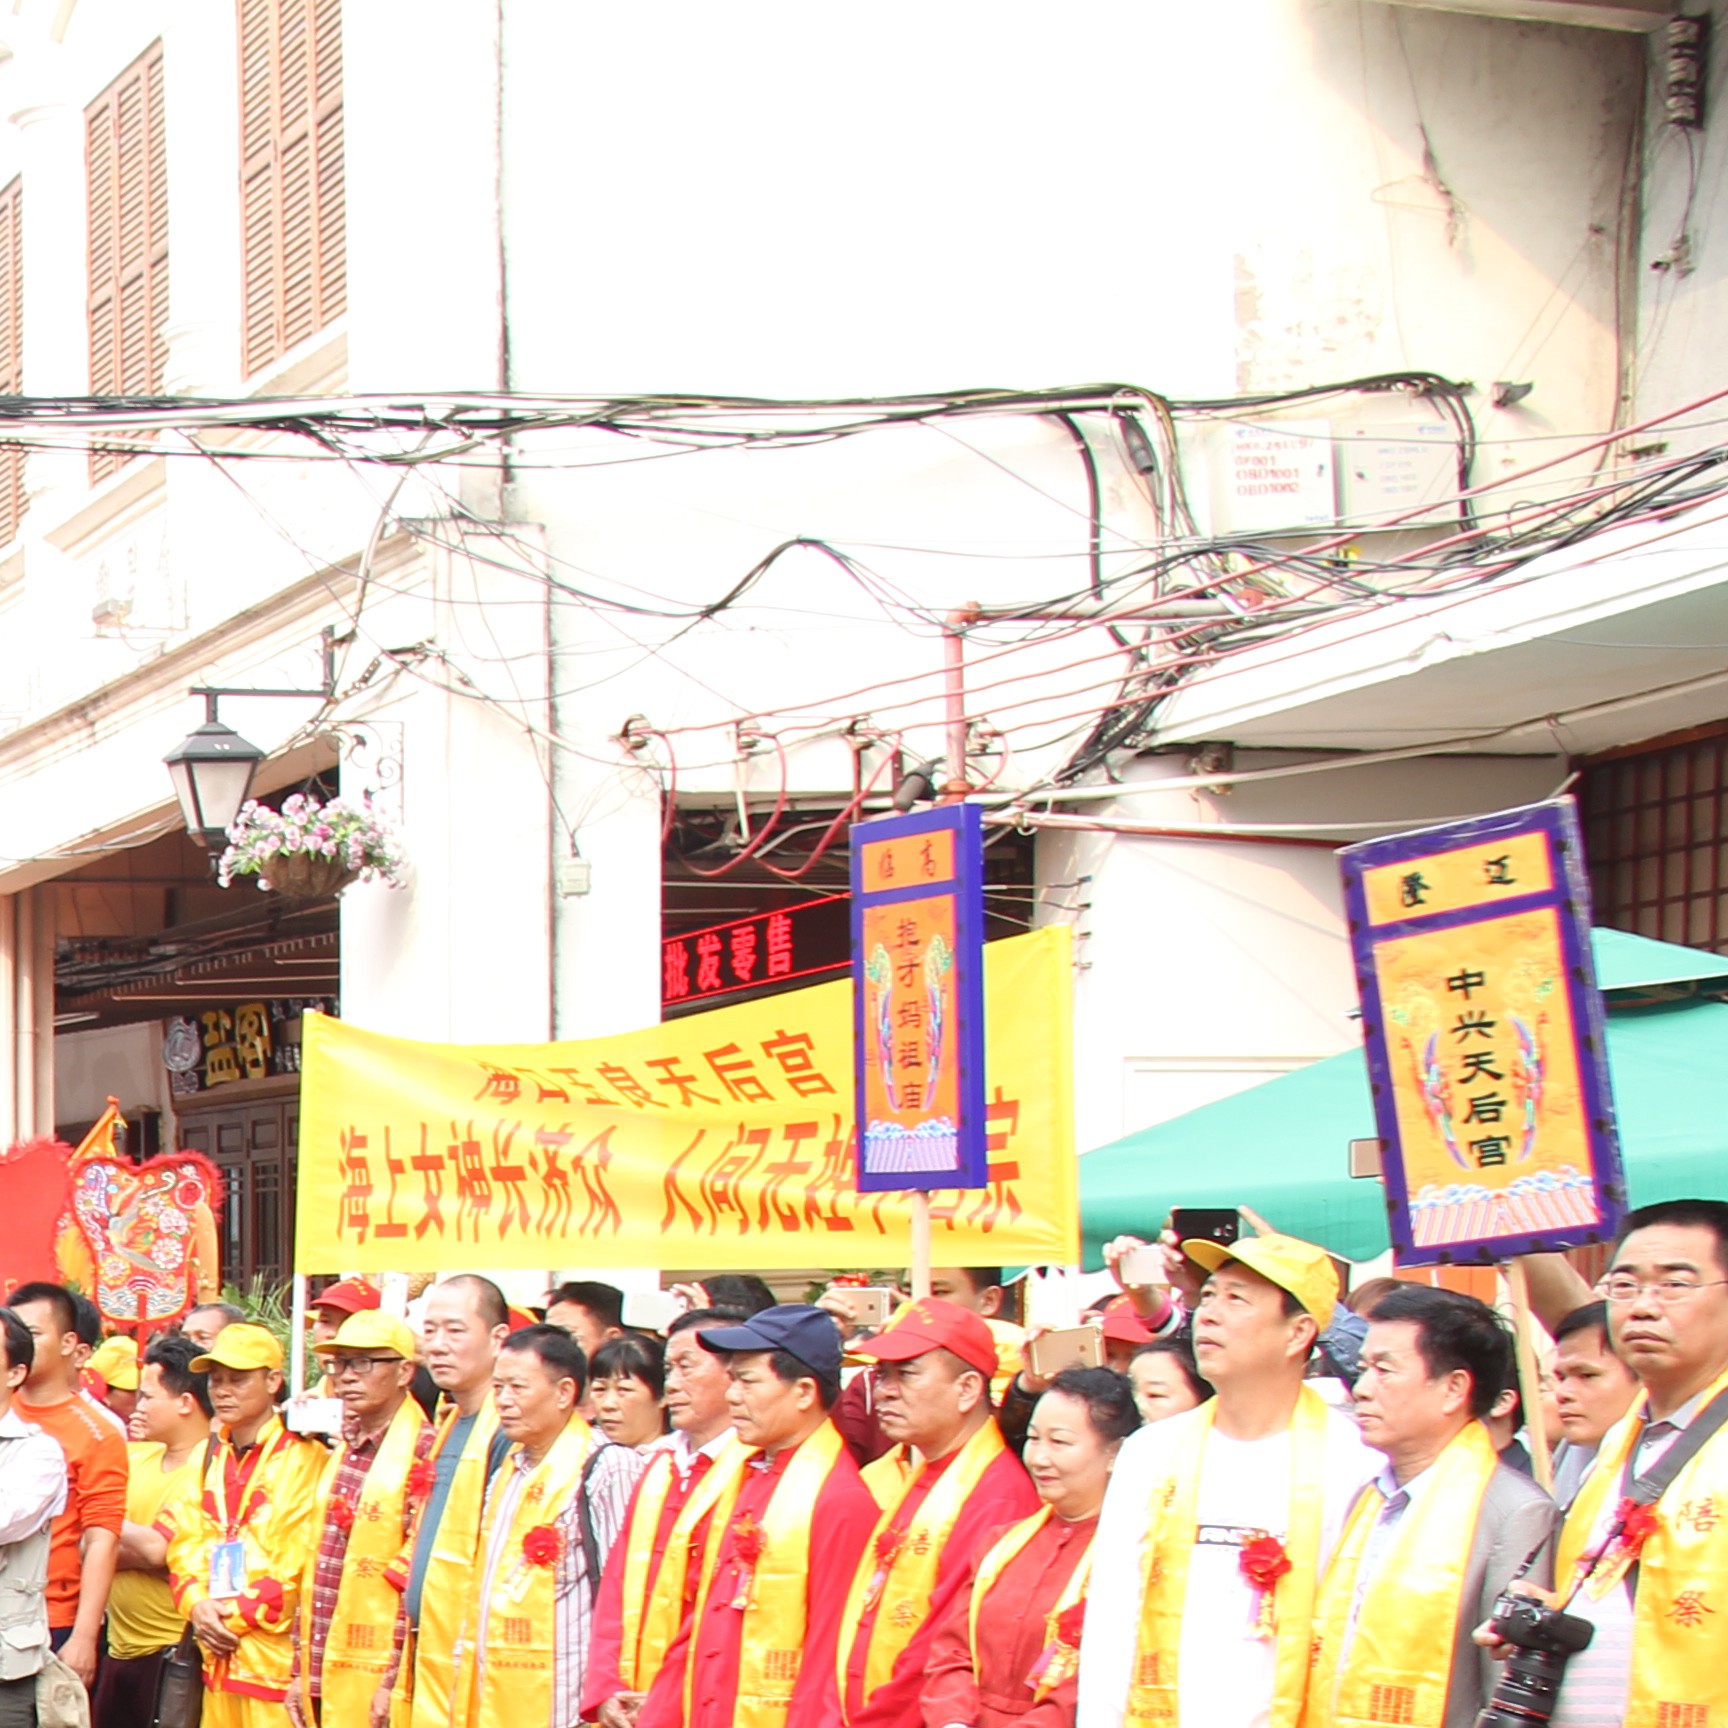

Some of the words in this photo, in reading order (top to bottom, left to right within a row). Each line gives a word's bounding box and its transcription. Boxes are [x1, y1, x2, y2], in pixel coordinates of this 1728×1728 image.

[663, 913, 793, 1000] 批发零售
[1445, 966, 1513, 1170] 中兴天后宫
[336, 1118, 624, 1246] 海上女神长济众
[1664, 1497, 1722, 1628] 陪祭
